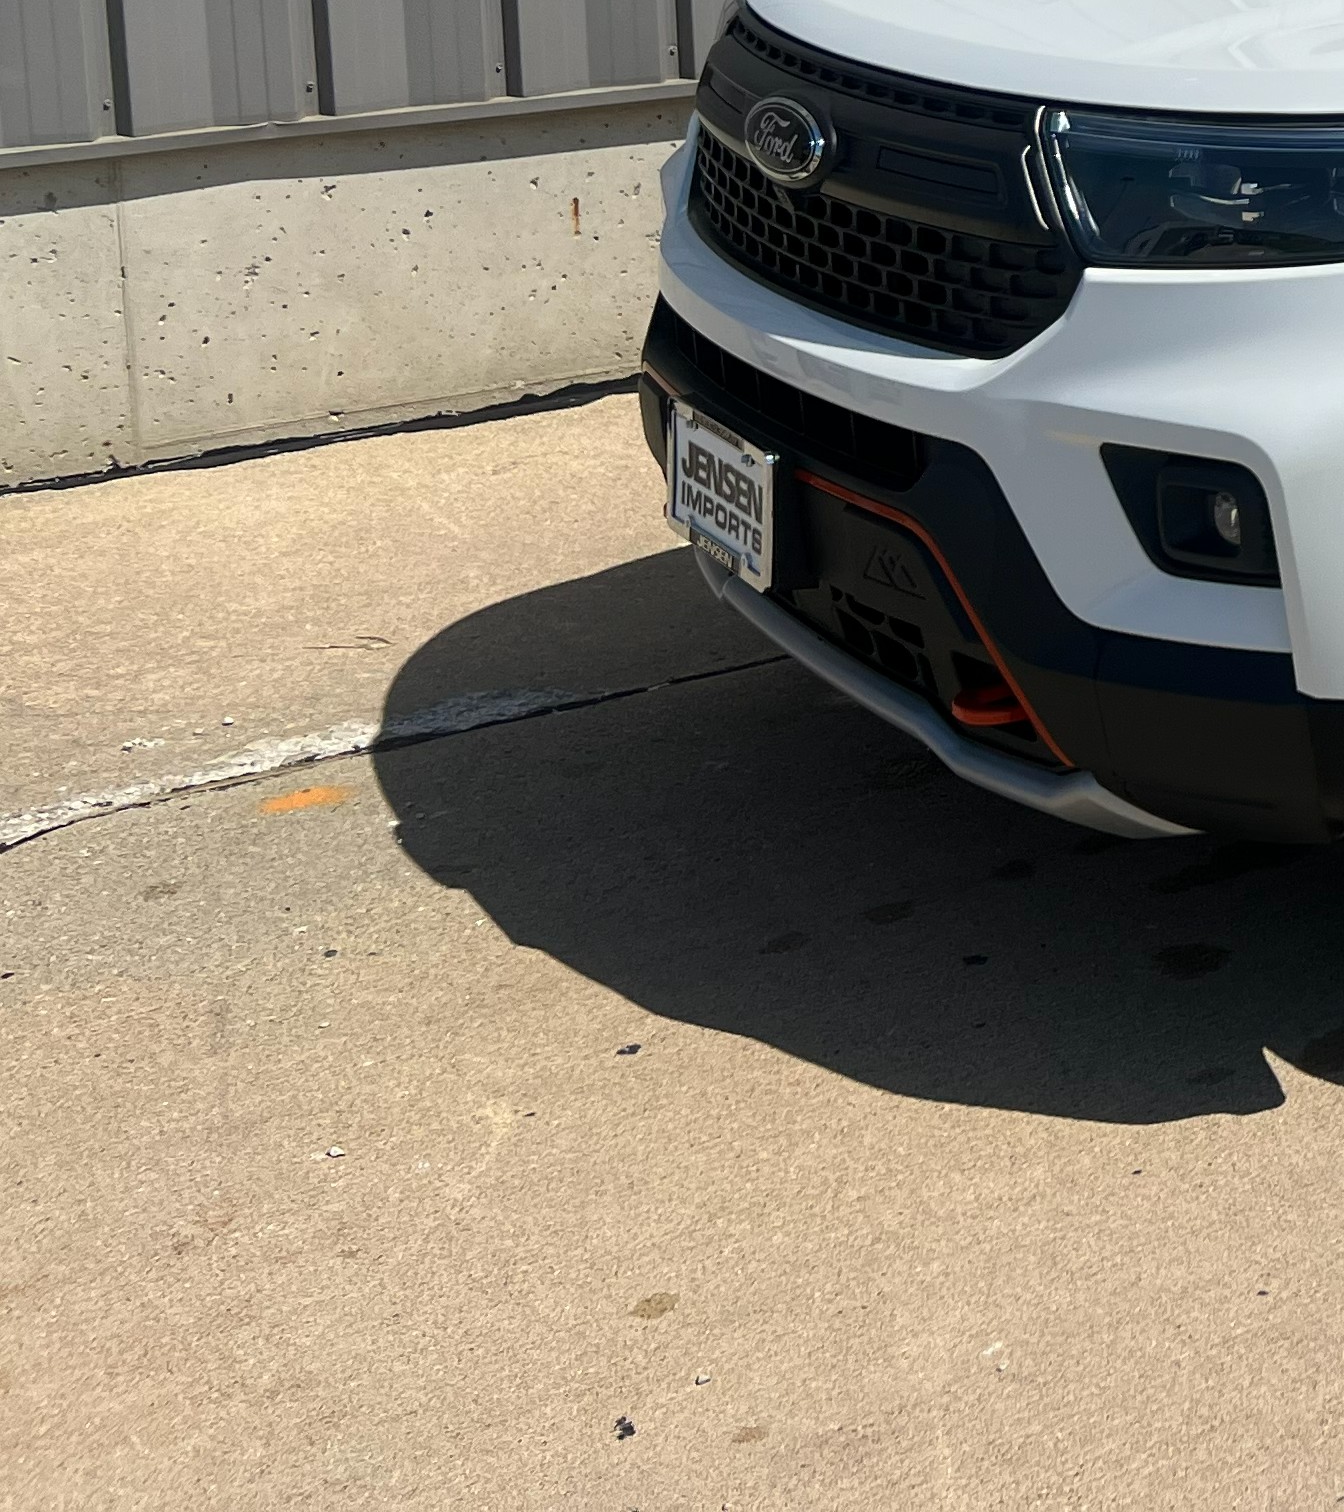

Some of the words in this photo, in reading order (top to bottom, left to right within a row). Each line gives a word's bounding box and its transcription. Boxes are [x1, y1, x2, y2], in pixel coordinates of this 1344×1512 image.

[754, 112, 798, 164] Ford
[682, 440, 763, 525] JENSEN
[682, 480, 762, 556] IMPORTS
